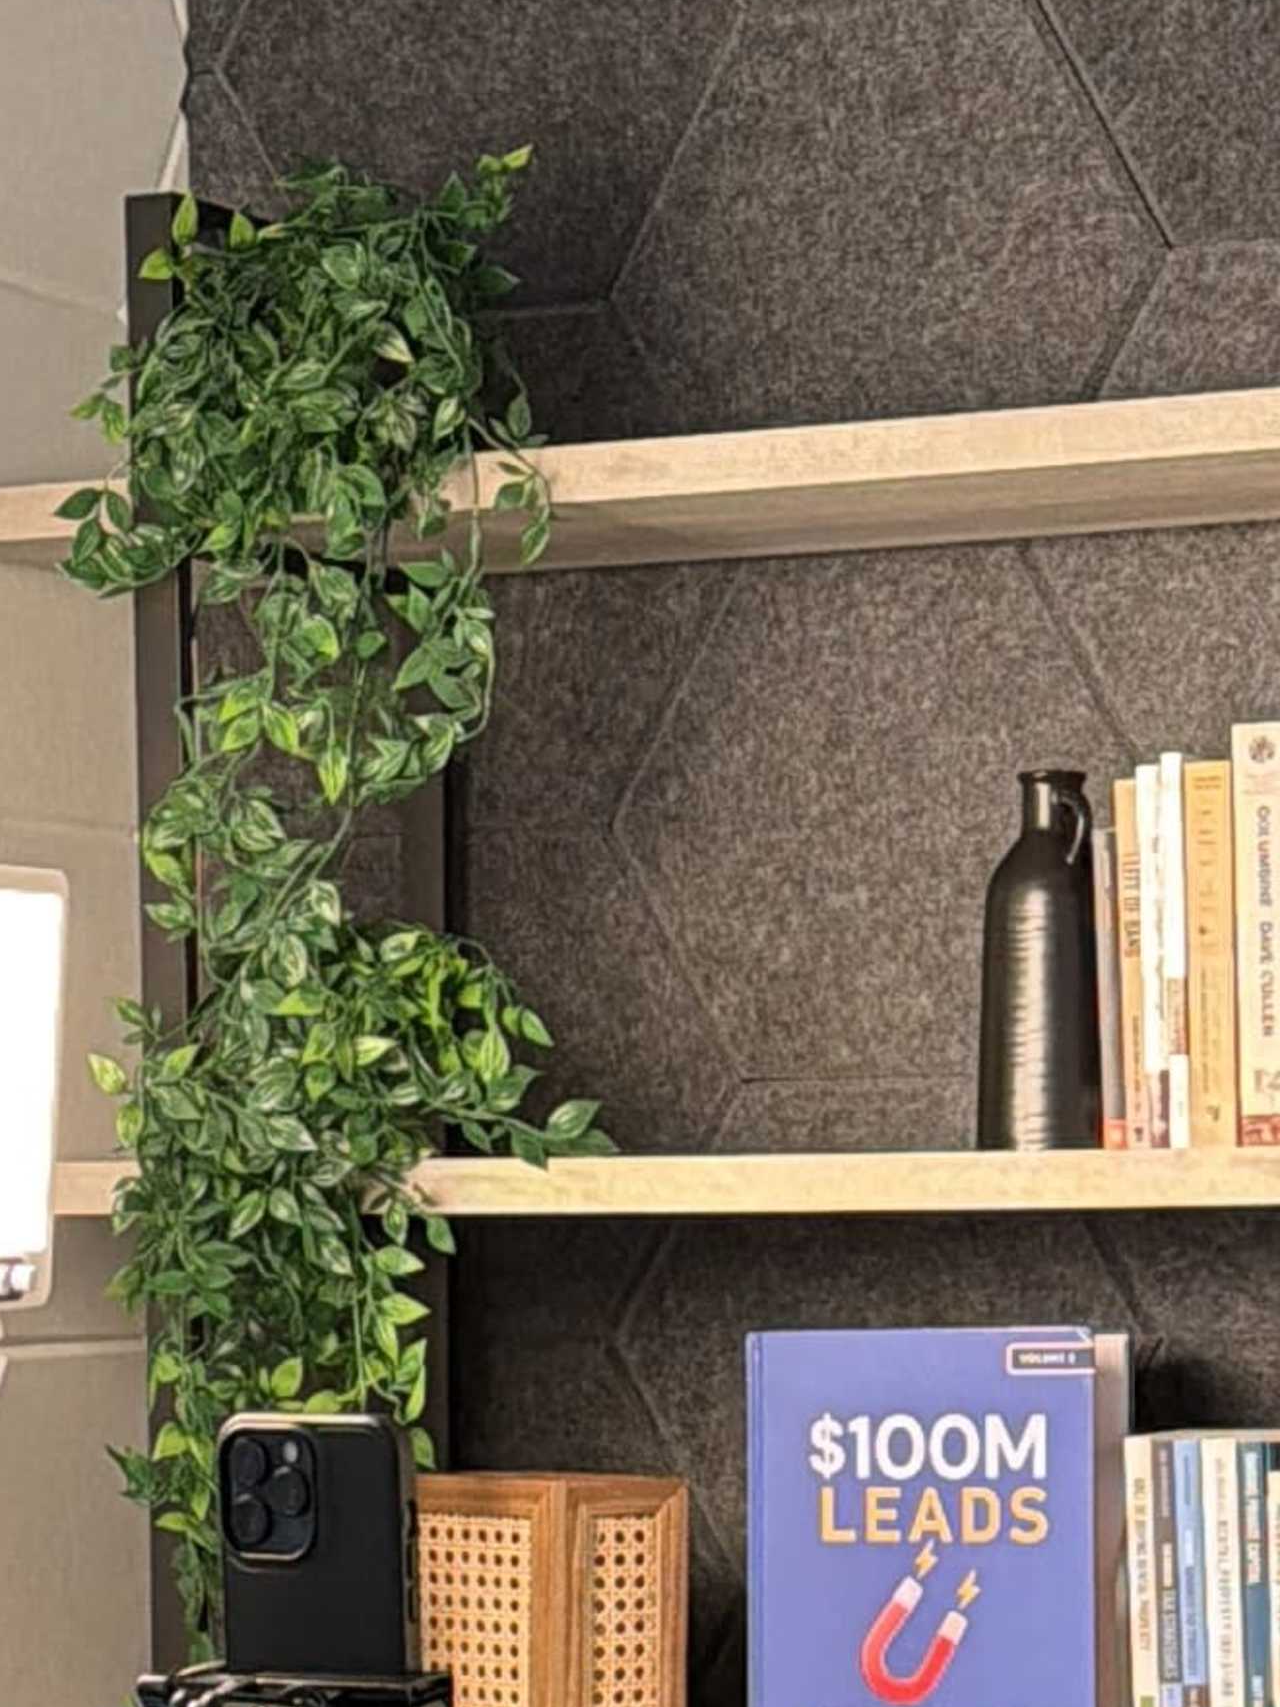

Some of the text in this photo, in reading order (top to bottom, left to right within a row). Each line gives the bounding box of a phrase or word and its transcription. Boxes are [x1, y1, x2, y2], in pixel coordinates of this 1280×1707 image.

[1258, 921, 1274, 965] DAVE
[809, 1412, 1047, 1481] $100M
[820, 1486, 1049, 1544] LEADS
